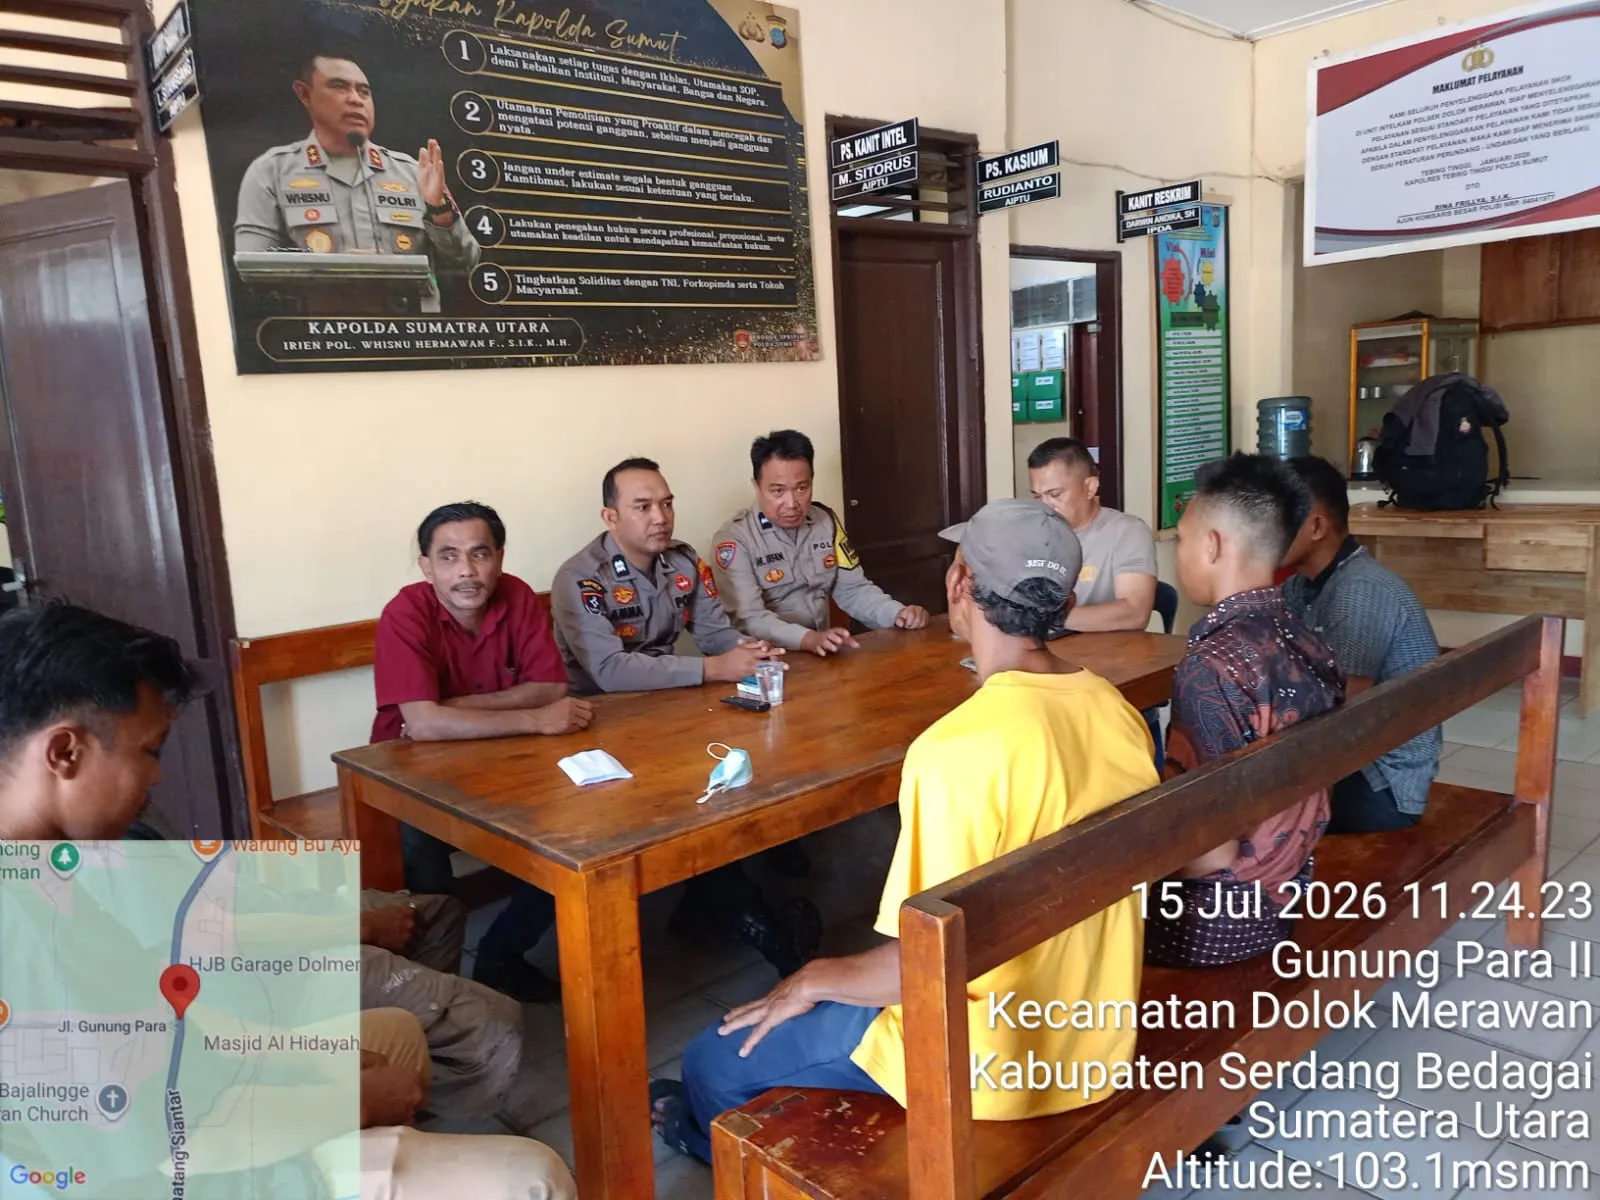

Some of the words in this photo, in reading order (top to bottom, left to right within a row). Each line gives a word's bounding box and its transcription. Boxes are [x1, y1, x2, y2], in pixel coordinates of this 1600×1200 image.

[460, 40, 470, 61] 1
[605, 19, 687, 62] Sumut
[489, 43, 556, 63] Laksanakan
[558, 56, 589, 70] setiap
[592, 62, 619, 74] tugas
[622, 66, 657, 80] dengan
[693, 78, 738, 93] Utamakan
[491, 56, 519, 69] demi
[522, 59, 571, 77] kebaikan
[683, 87, 714, 99] Bangsa
[717, 92, 734, 102] dan
[1432, 76, 1476, 94] MAKLUMAT
[1478, 65, 1524, 84] PELAYANAN
[465, 101, 481, 122] 2
[496, 99, 552, 116] Utamakan
[556, 107, 611, 124] Pemolisian
[614, 117, 639, 128] yang
[642, 118, 679, 132] Proaktif
[682, 125, 710, 137] dalam
[712, 130, 754, 143] mencegah
[757, 135, 773, 144] dan
[497, 113, 553, 128] mengatasi
[556, 121, 593, 133] potensi
[651, 131, 688, 144] sebelum
[691, 137, 726, 149] menjadi
[728, 141, 769, 153] gangguan
[499, 123, 536, 135] nyata.
[841, 142, 853, 161] PS.
[854, 133, 880, 157] KANIT
[881, 126, 907, 149] INTEL
[471, 159, 487, 180] 3
[839, 172, 852, 185] M.
[855, 156, 912, 181] SITORUS
[985, 161, 1002, 179] PS.
[1004, 148, 1049, 174] KASIUM
[503, 161, 542, 175] Jangan
[544, 166, 575, 178] under
[578, 170, 620, 182] estimate
[622, 174, 653, 185] segala
[655, 176, 687, 188] bentuk
[689, 180, 733, 192] gangguan
[862, 177, 889, 191] AIPTU
[983, 175, 1053, 199] RUDIANTO
[285, 193, 330, 205] WHISNU
[378, 195, 416, 207] POLRI
[571, 180, 612, 191] lakukan
[615, 184, 644, 194] sesuai
[647, 186, 692, 198] ketentuan
[695, 191, 718, 202] yang
[1005, 194, 1030, 207] AIPTU
[1128, 194, 1153, 211] KANIT
[1154, 186, 1191, 206] RESKRIM
[477, 215, 493, 235] 4
[1126, 216, 1153, 228] DARWIN
[1184, 209, 1195, 218] SH
[1147, 224, 1172, 234] IPDA
[509, 218, 552, 229] Lakukan
[555, 221, 604, 233] penegakan
[607, 224, 638, 234] hukum
[640, 228, 667, 236] secara
[767, 235, 785, 243] serta
[510, 230, 560, 241] utamakan
[562, 231, 602, 242] keadilan
[604, 234, 631, 244] untuk
[633, 235, 690, 247] mendapatkan
[483, 272, 498, 291] 5
[514, 273, 576, 286] Tingkatkan
[579, 275, 621, 286] Soliditas
[623, 277, 658, 288] dengan
[683, 279, 735, 290] Forkopimda
[738, 281, 758, 290] serta
[760, 280, 785, 290] Tokoh
[516, 285, 583, 297] Masyarakat.
[308, 321, 399, 334] KAPOLDA
[406, 321, 489, 334] SUMATRA
[496, 321, 550, 333] UTARA
[325, 340, 356, 350] POL.
[361, 340, 410, 349] WHISNU
[415, 339, 485, 349] HERMAWAN
[546, 338, 571, 347] M.H.
[1025, 559, 1047, 568] JUST
[1047, 561, 1060, 570] DO
